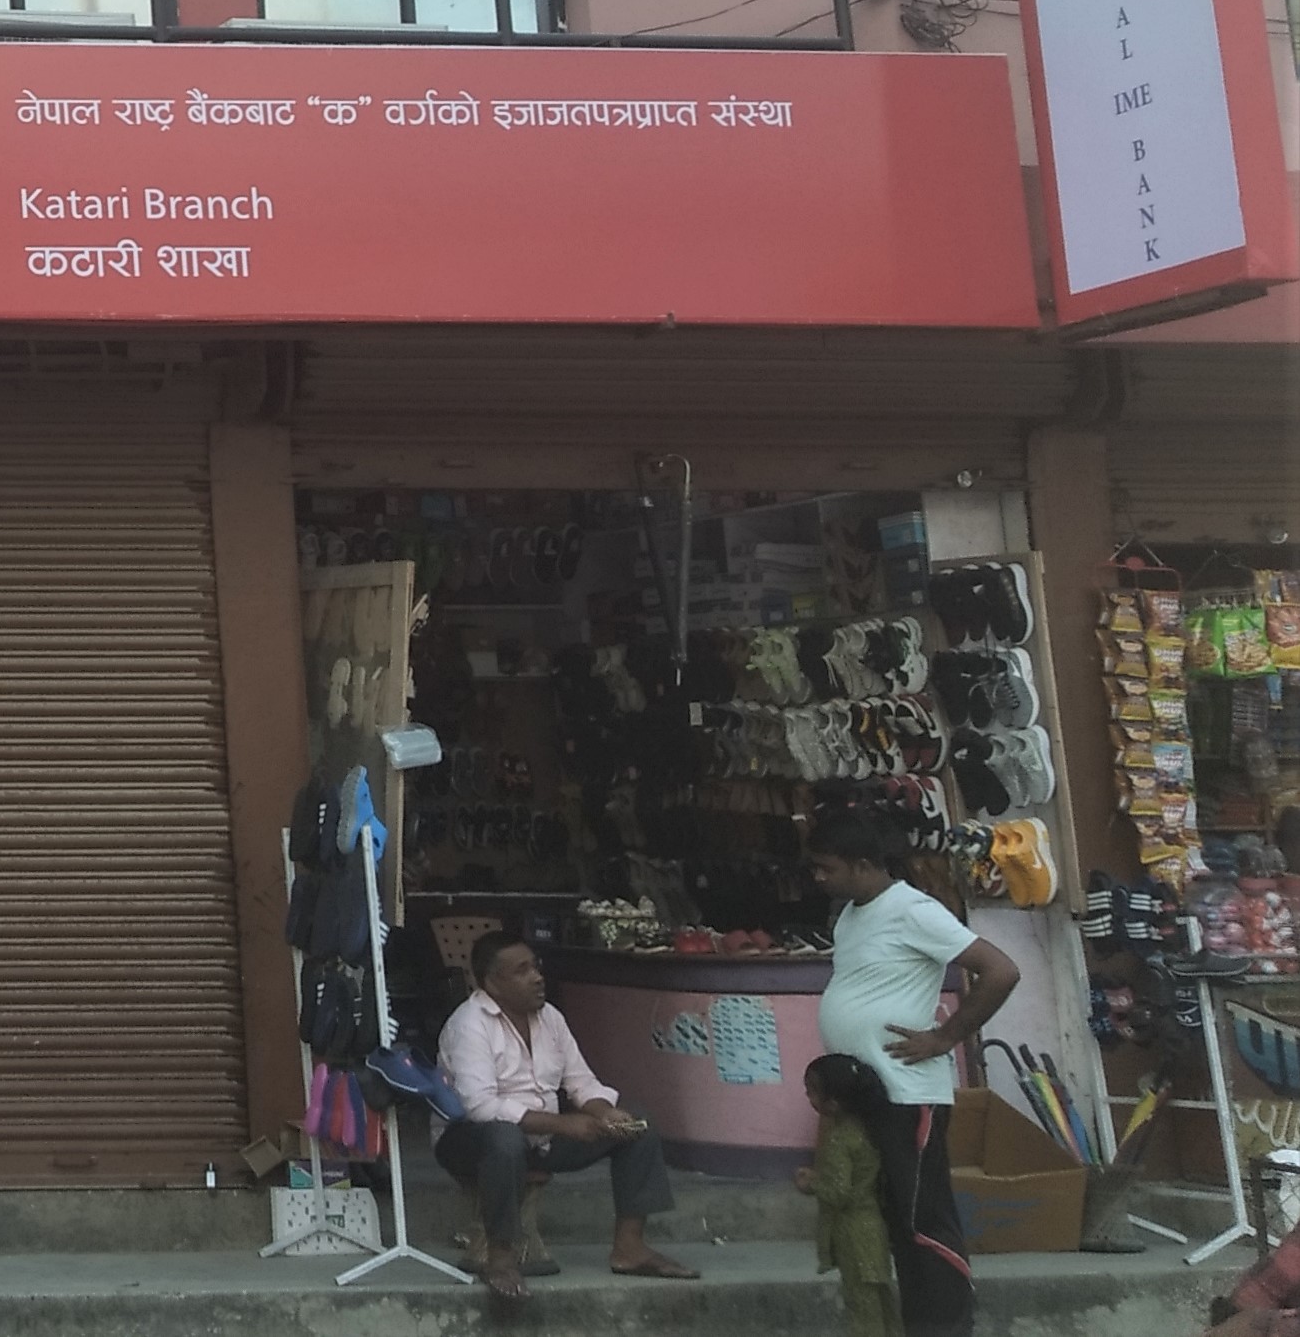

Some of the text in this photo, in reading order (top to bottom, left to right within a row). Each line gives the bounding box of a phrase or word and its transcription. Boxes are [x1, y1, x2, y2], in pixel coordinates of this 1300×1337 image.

[14, 88, 102, 125] नेपाल
[111, 99, 176, 131] राष्ट्र
[184, 87, 297, 126] बैंकबाट
[382, 89, 481, 126] वर्गको
[707, 94, 793, 127] संस्था
[1113, 82, 1153, 116] IME
[20, 186, 274, 220] Katari Branch
[1131, 138, 1161, 262] BANK
[24, 239, 251, 277] कटारी शाखा
